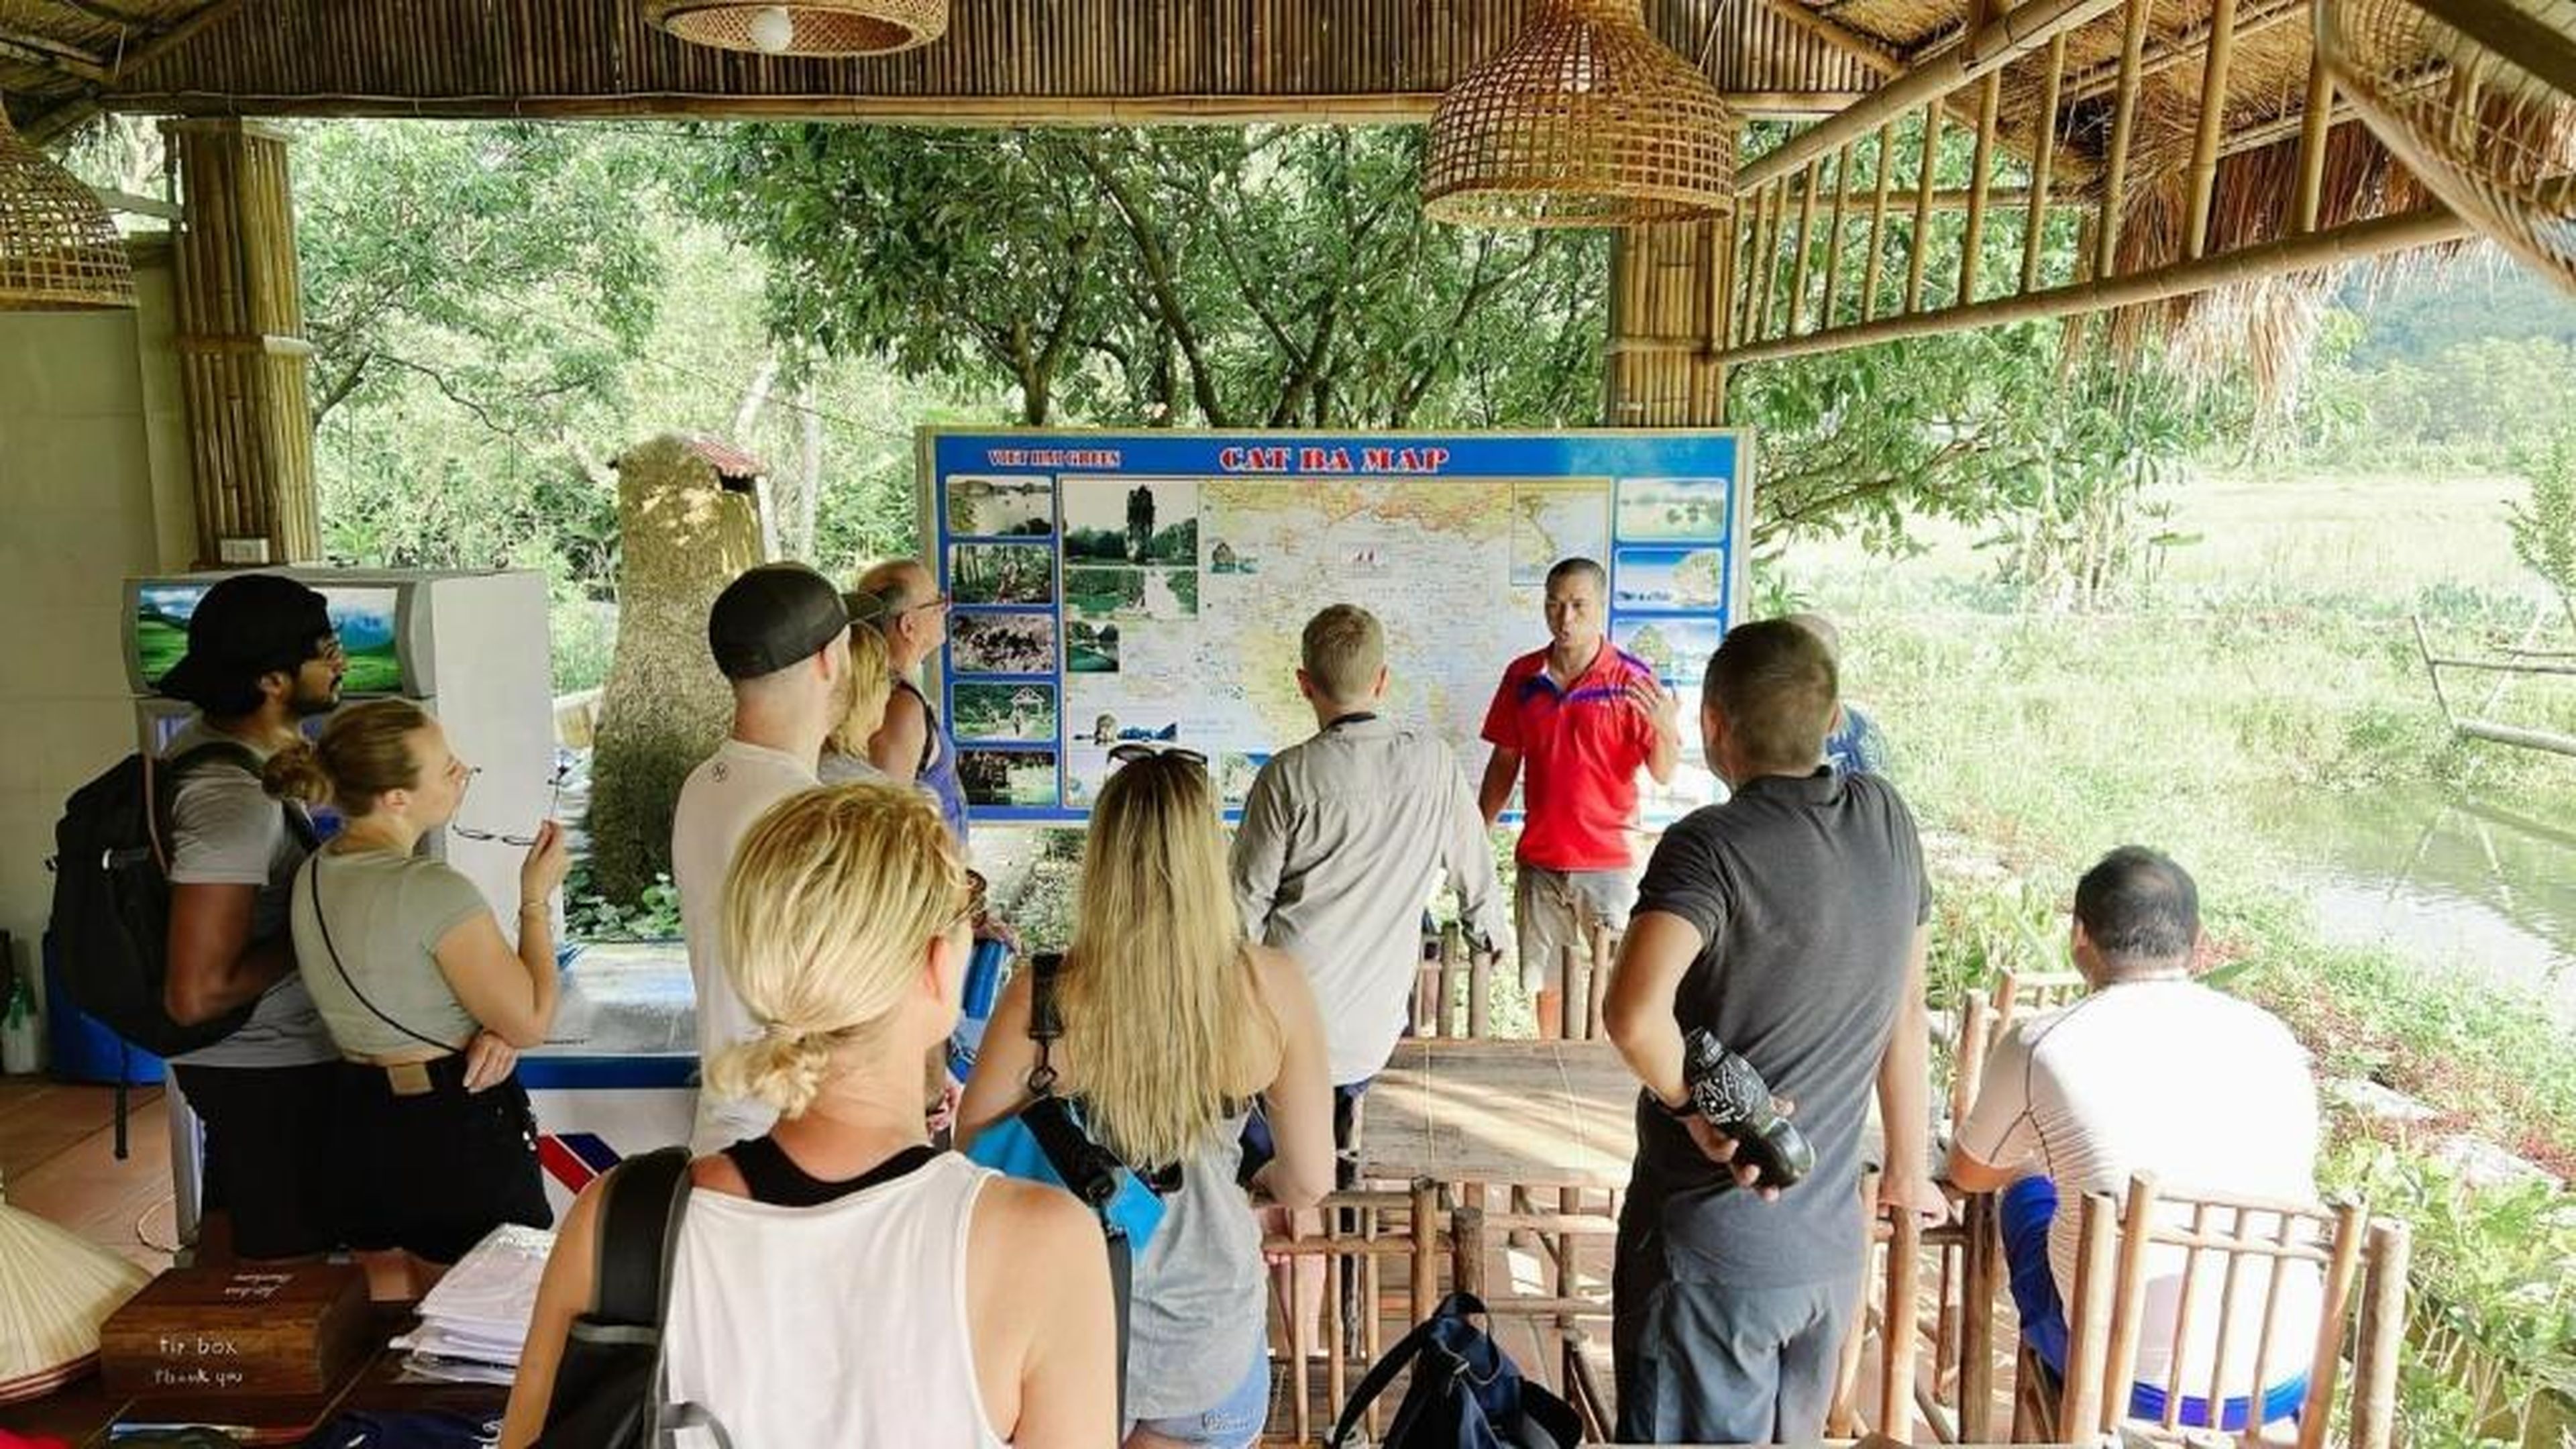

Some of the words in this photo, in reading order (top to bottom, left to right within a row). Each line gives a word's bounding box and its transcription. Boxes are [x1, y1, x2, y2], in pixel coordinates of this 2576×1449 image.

[1220, 447, 1291, 472] CAT
[1299, 447, 1355, 473] BA
[1361, 447, 1450, 474] MAP
[197, 1336, 238, 1355] box
[215, 1371, 244, 1388] you
